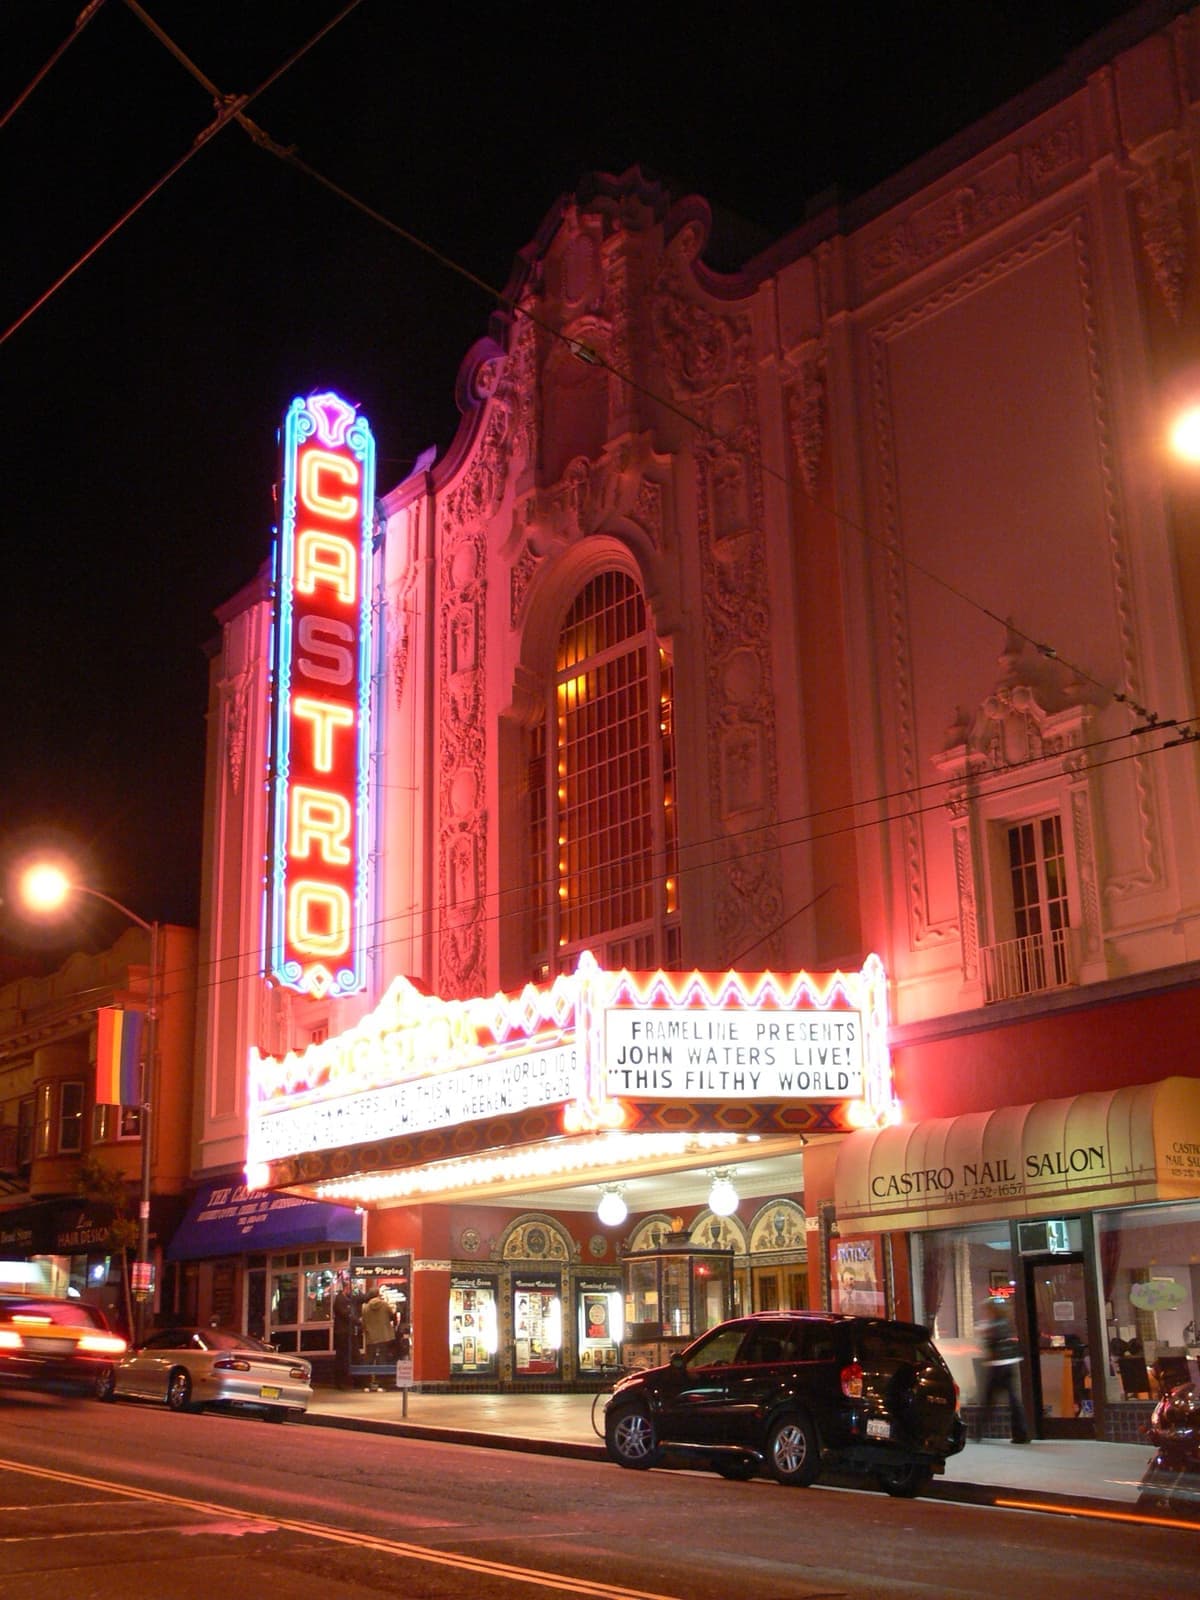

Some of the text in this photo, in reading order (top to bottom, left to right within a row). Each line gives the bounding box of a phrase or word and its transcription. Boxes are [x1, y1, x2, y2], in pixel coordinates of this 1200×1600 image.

[287, 447, 360, 957] CASTRO
[631, 1020, 856, 1042] FRAMELINE PRESENTS
[617, 1046, 853, 1066] JOHN WATERS LIVE!
[502, 1058, 548, 1085] WORLD
[685, 1070, 761, 1091] FILTHY
[871, 1146, 1105, 1198] CASTRO NAIL SALON
